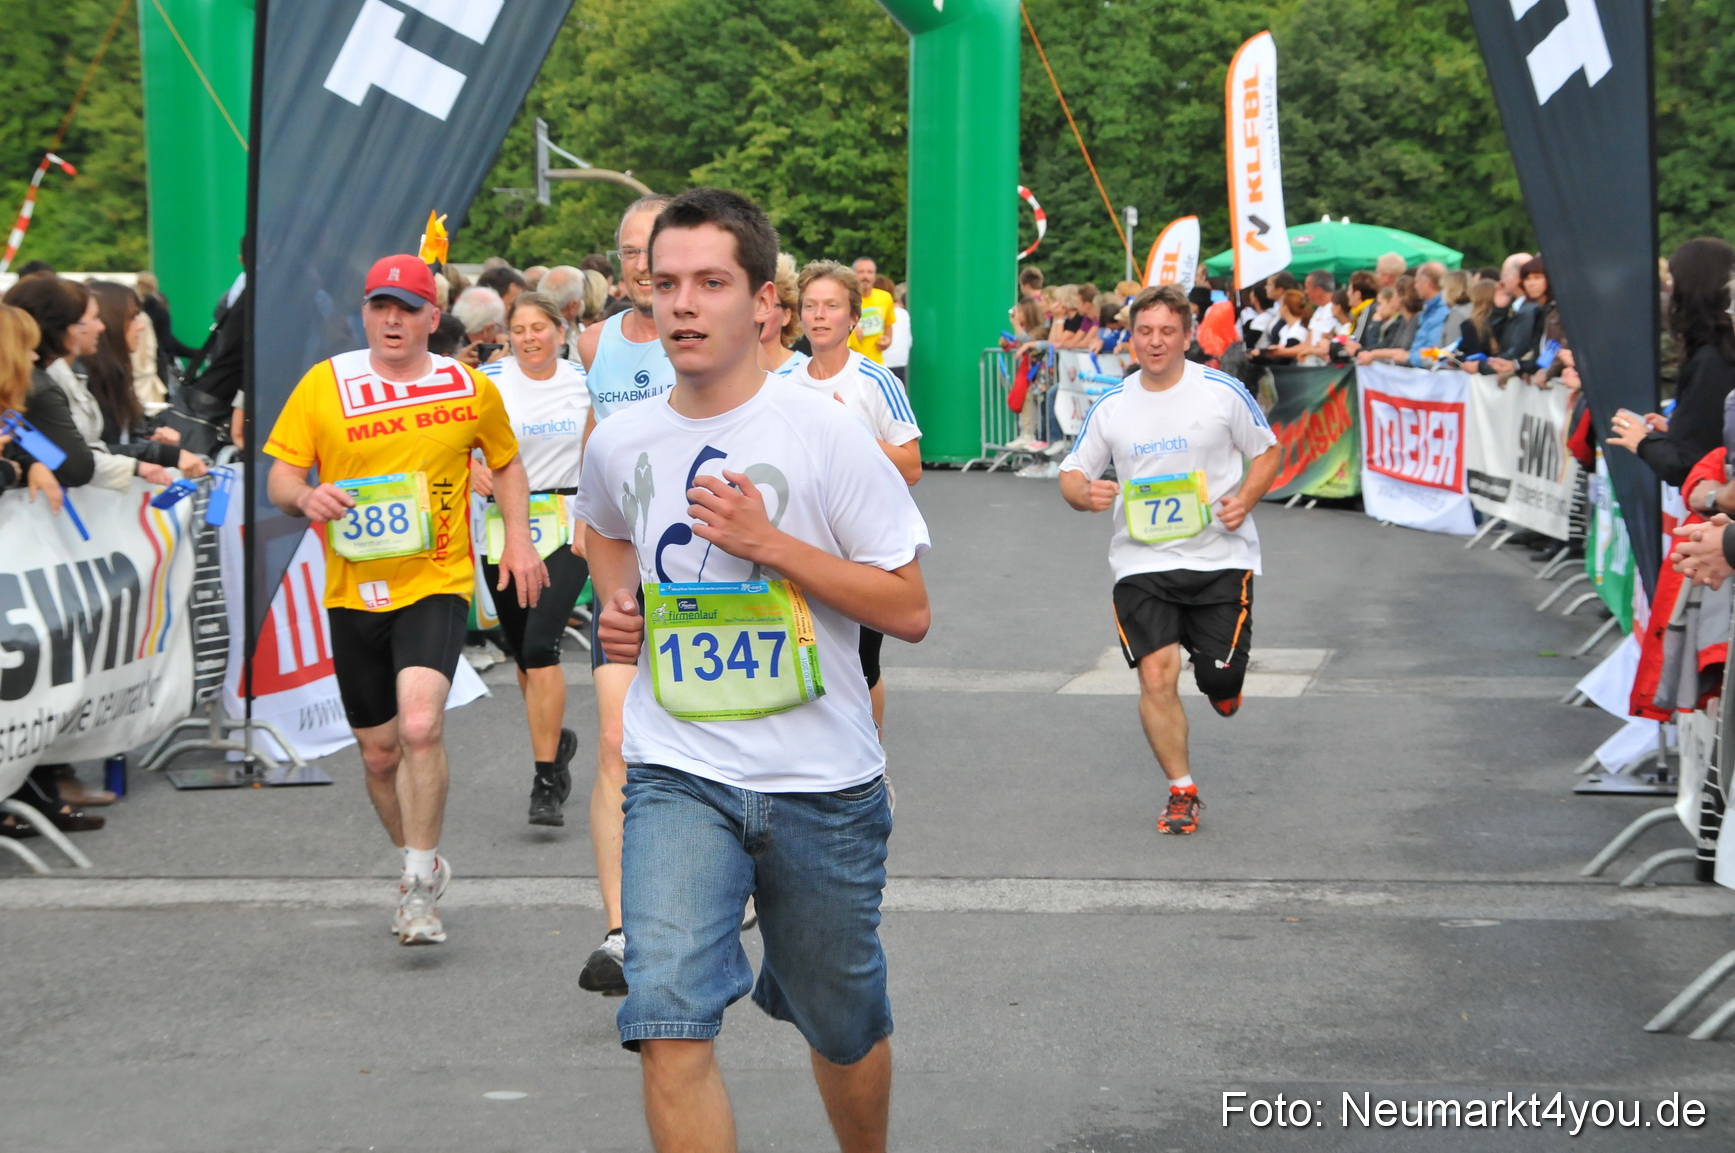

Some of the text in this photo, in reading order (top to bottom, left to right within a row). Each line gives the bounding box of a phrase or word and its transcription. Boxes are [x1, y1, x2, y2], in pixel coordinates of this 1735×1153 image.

[346, 405, 478, 442] MAX BÖGL
[522, 418, 576, 436] heinloth
[1133, 436, 1188, 456] heinloth
[1369, 399, 1459, 487] MEIER
[343, 503, 409, 540] 388
[1145, 498, 1183, 525] 72
[669, 610, 718, 620] firmenlauf
[659, 631, 786, 682] 1347
